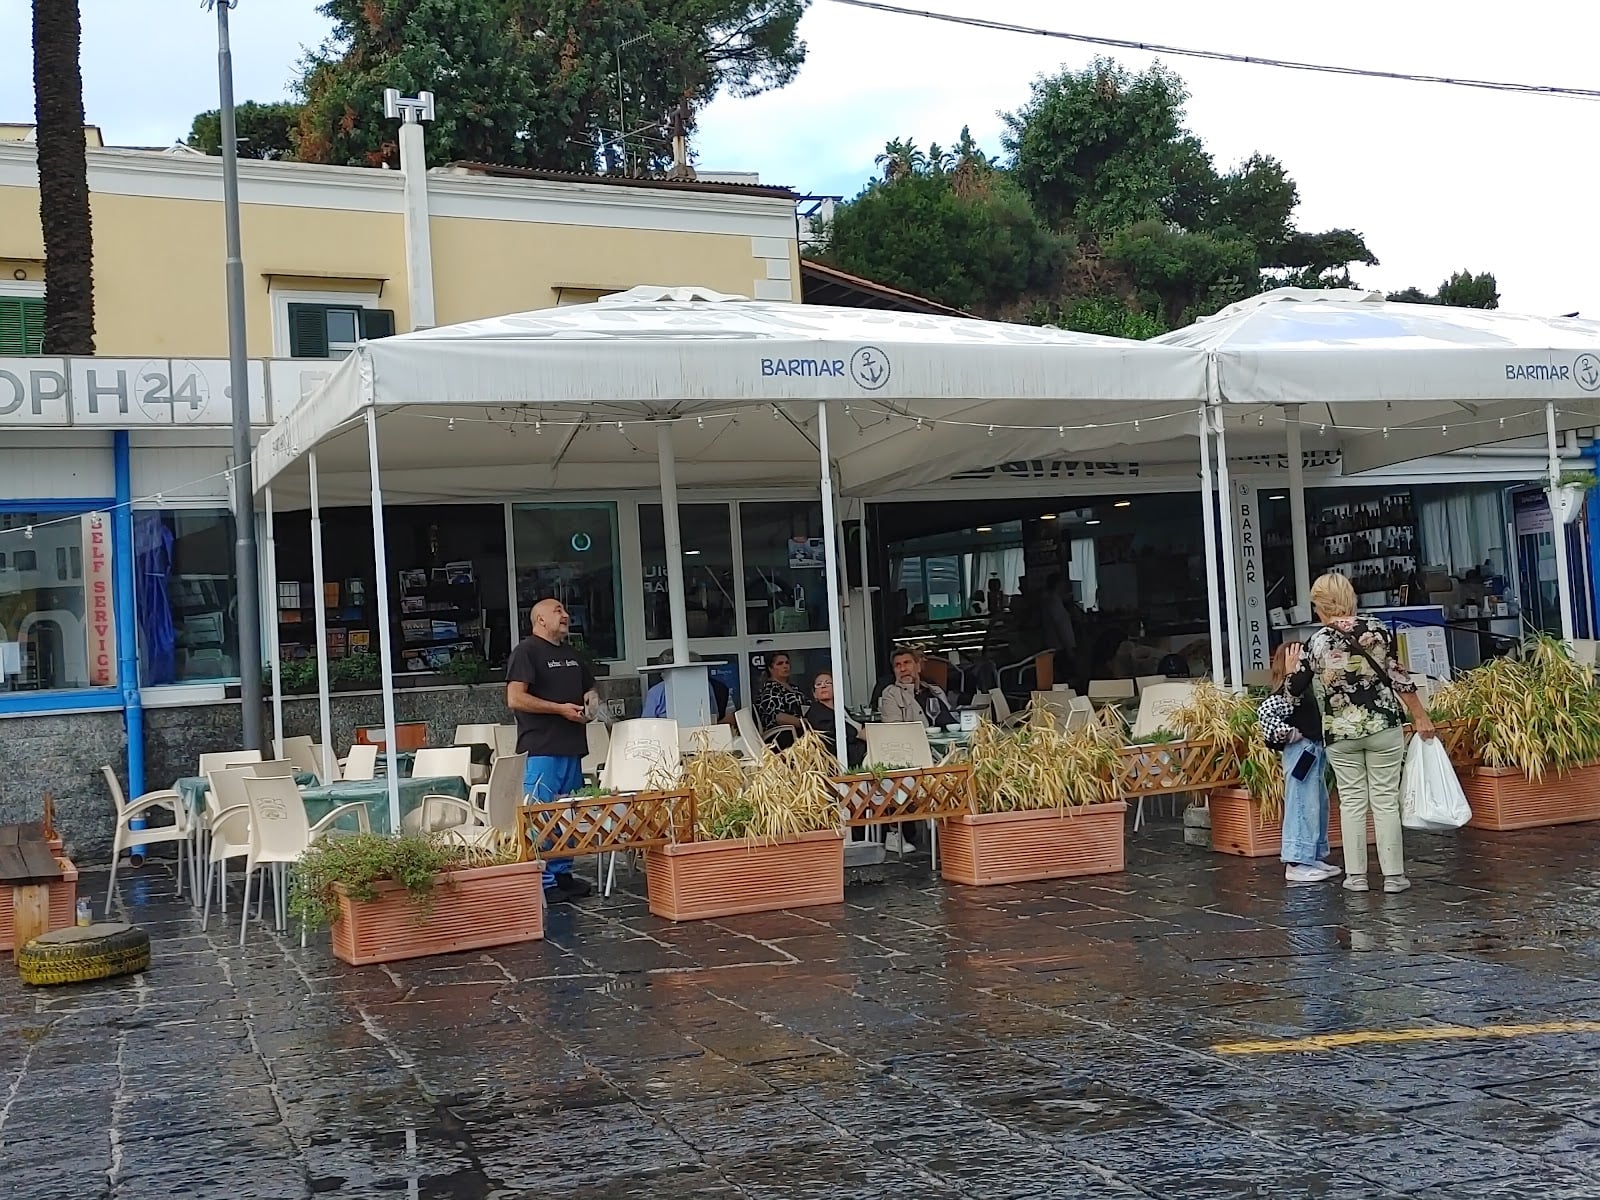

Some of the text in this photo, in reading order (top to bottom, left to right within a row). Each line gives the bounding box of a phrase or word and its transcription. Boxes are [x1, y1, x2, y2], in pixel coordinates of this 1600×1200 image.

[760, 358, 845, 377] BARMAR
[1505, 364, 1570, 381] BARMAR
[1241, 504, 1256, 584] BARMAR
[90, 517, 109, 682] SELF SERVICE
